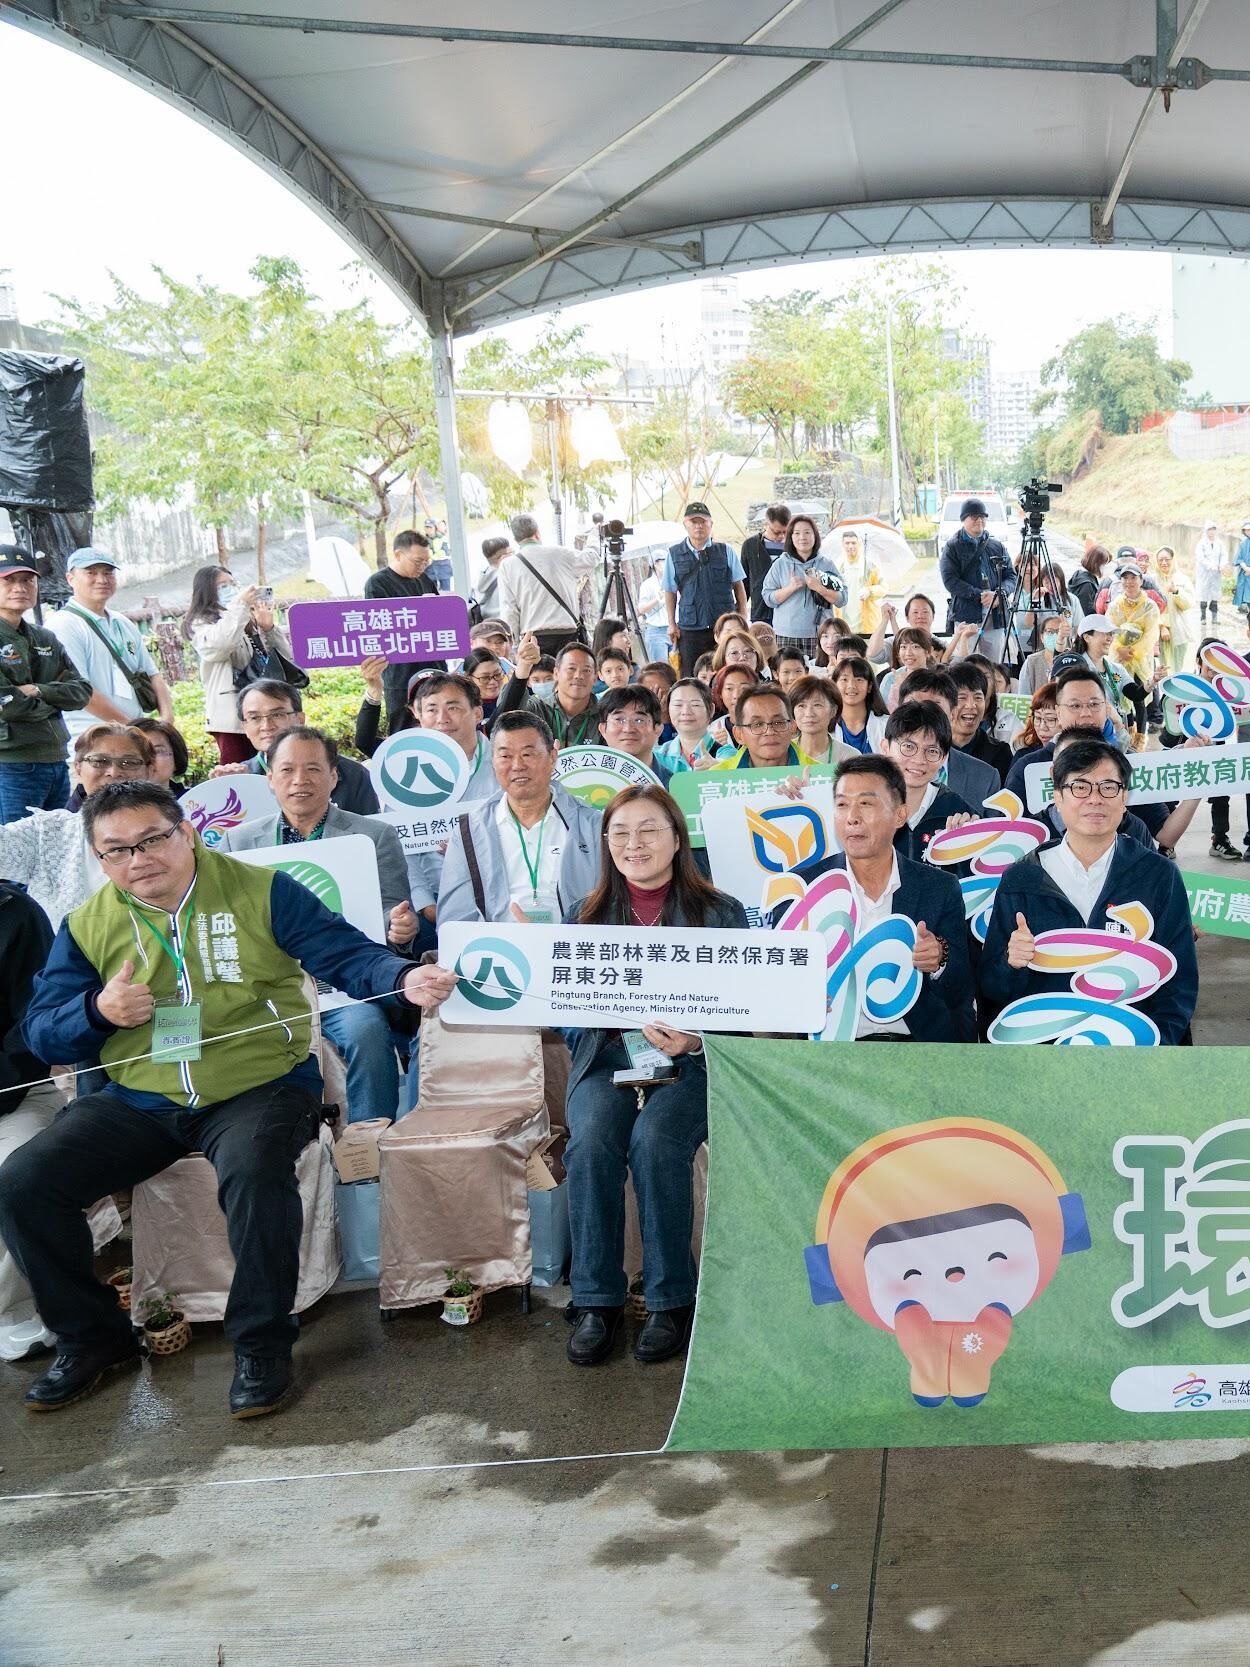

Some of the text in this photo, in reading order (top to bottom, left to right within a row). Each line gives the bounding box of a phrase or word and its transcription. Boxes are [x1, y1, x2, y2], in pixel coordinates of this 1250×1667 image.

[341, 607, 418, 633] 高雄市
[307, 629, 460, 660] 鳳山區北門里
[404, 841, 429, 849] Nature
[551, 940, 810, 968] 農業部林業及自然保育署
[551, 966, 644, 986] 屏東分署
[551, 990, 720, 1003] Pingtung Branch, Forestry And Nature
[612, 1003, 649, 1014] Agency,
[650, 1004, 686, 1015] Ministry
[687, 1005, 698, 1014] Of
[700, 1006, 750, 1016] Agriculture
